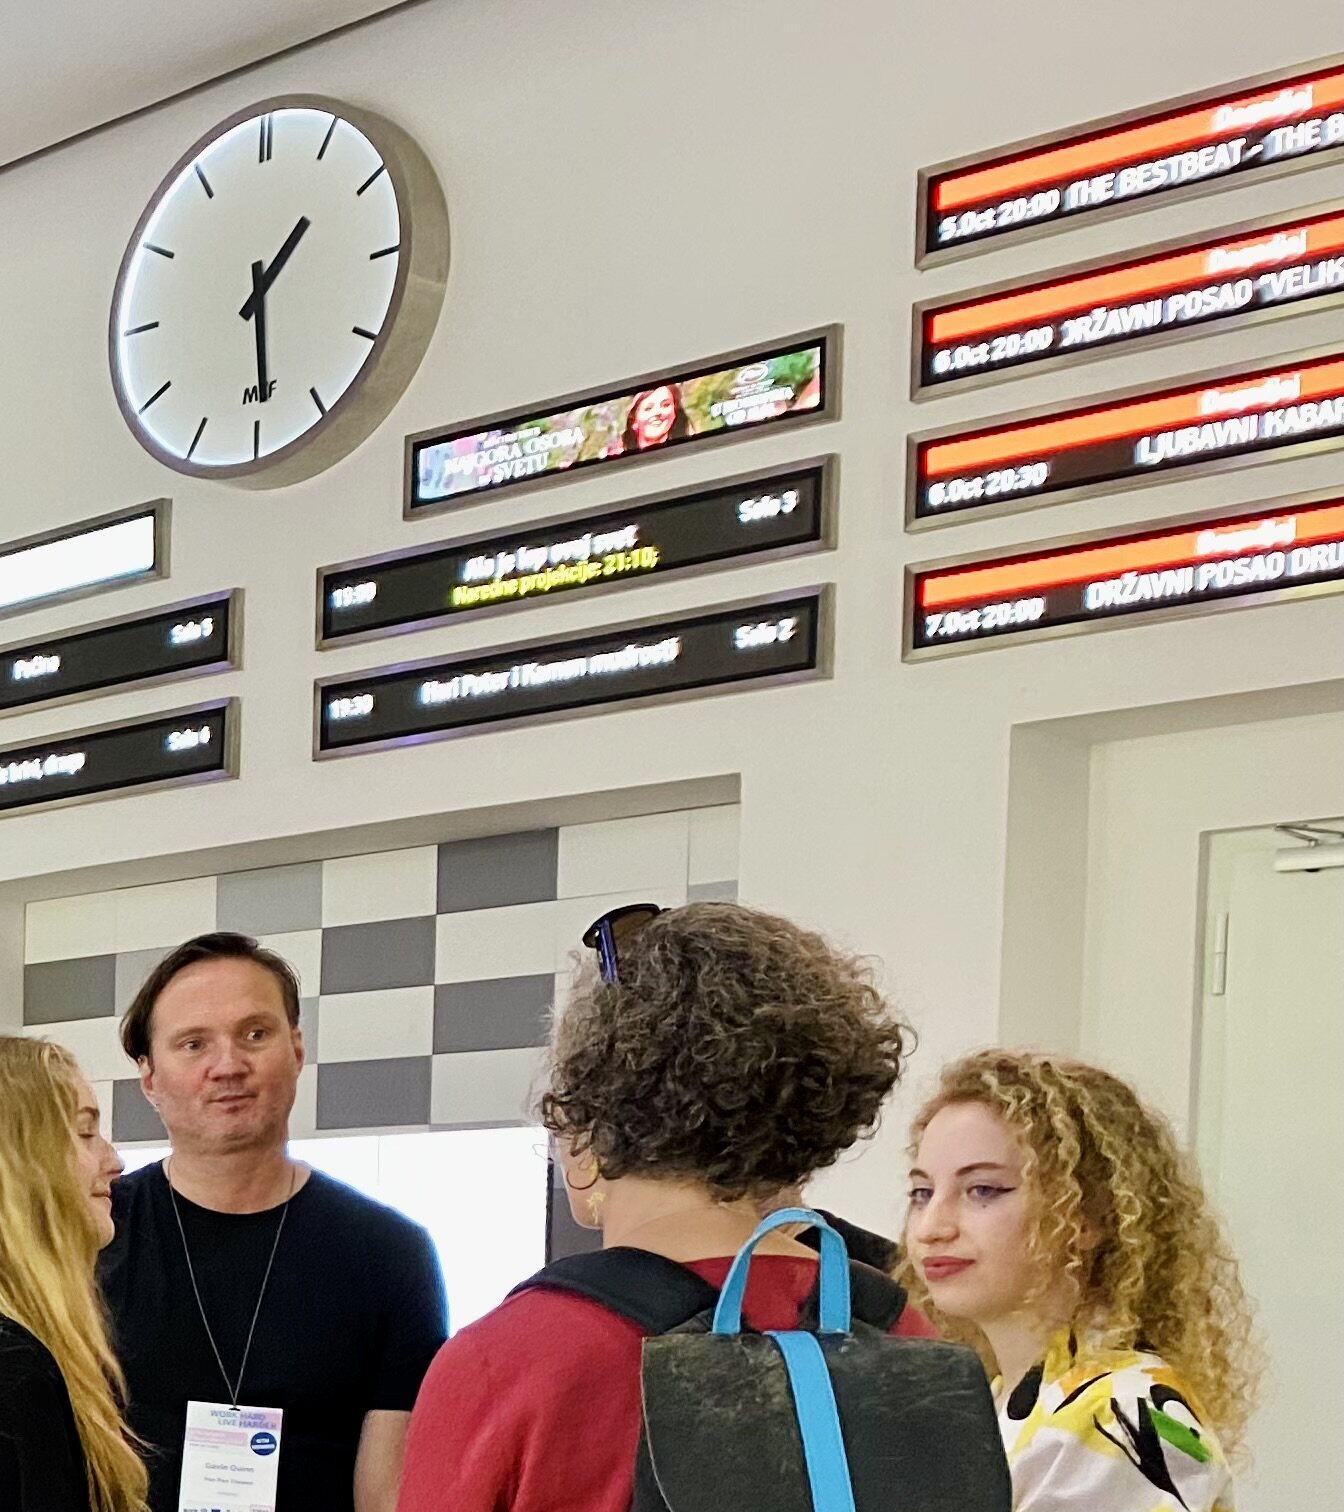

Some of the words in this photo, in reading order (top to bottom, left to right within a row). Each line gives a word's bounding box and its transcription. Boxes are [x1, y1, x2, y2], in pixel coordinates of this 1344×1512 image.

[997, 188, 1060, 224] 20:00
[1064, 172, 1114, 209] THE
[1115, 138, 1246, 198] BESTBEAT
[1266, 118, 1322, 157] THE
[991, 326, 1054, 361] 20:00
[1164, 278, 1252, 323] POSAO
[524, 426, 586, 454] OSOBA
[492, 451, 549, 484] SVETU
[985, 462, 1049, 496] 20:30
[1135, 415, 1258, 466] LJUBAVNI
[737, 496, 782, 523] Sala
[782, 489, 799, 514] 3
[981, 597, 1045, 630] 20:00
[1085, 566, 1194, 611] DRŽAVNI
[1195, 551, 1285, 591] POSAO
[170, 620, 202, 645] Sala
[734, 623, 780, 650] Sala
[167, 727, 199, 752] Sala
[210, 1410, 237, 1419] WORK
[240, 1412, 266, 1420] HARD
[239, 1420, 277, 1429] HARDER
